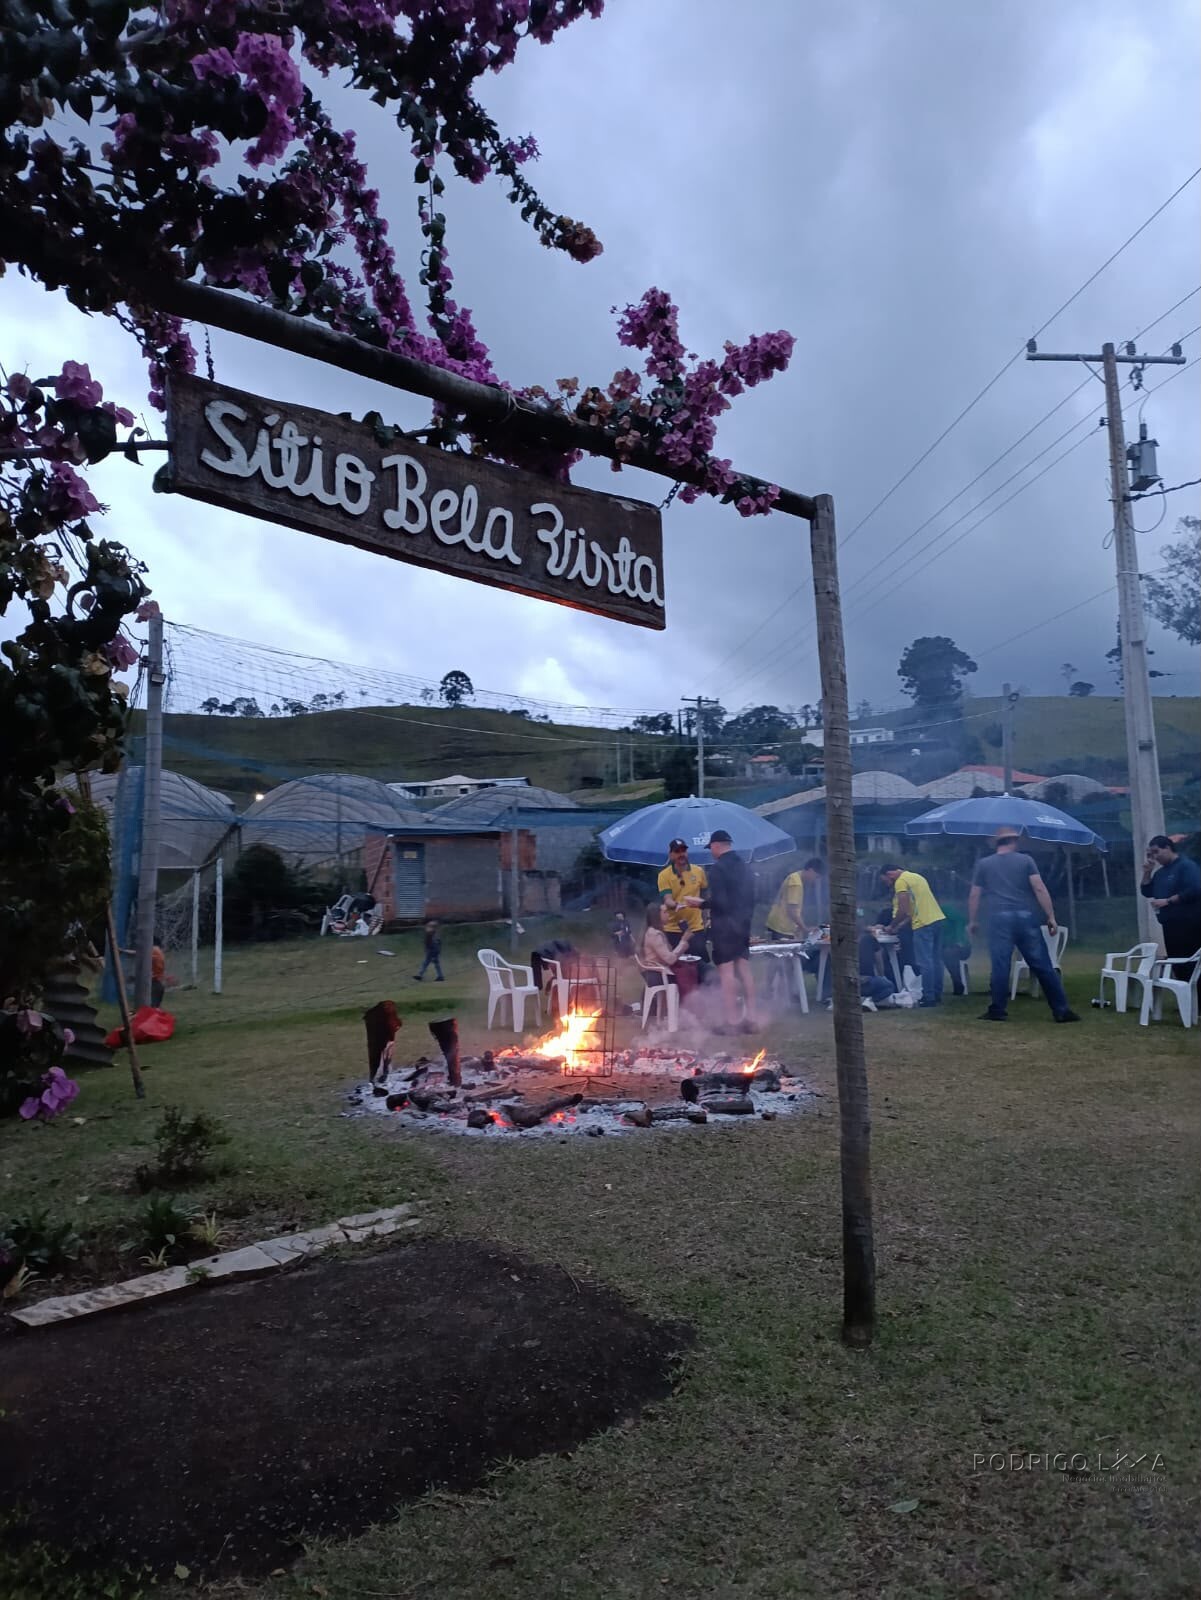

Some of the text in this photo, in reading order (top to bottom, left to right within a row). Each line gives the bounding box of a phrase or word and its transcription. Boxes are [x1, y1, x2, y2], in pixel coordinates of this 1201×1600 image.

[200, 400, 665, 607] Sítio Bela Vista
